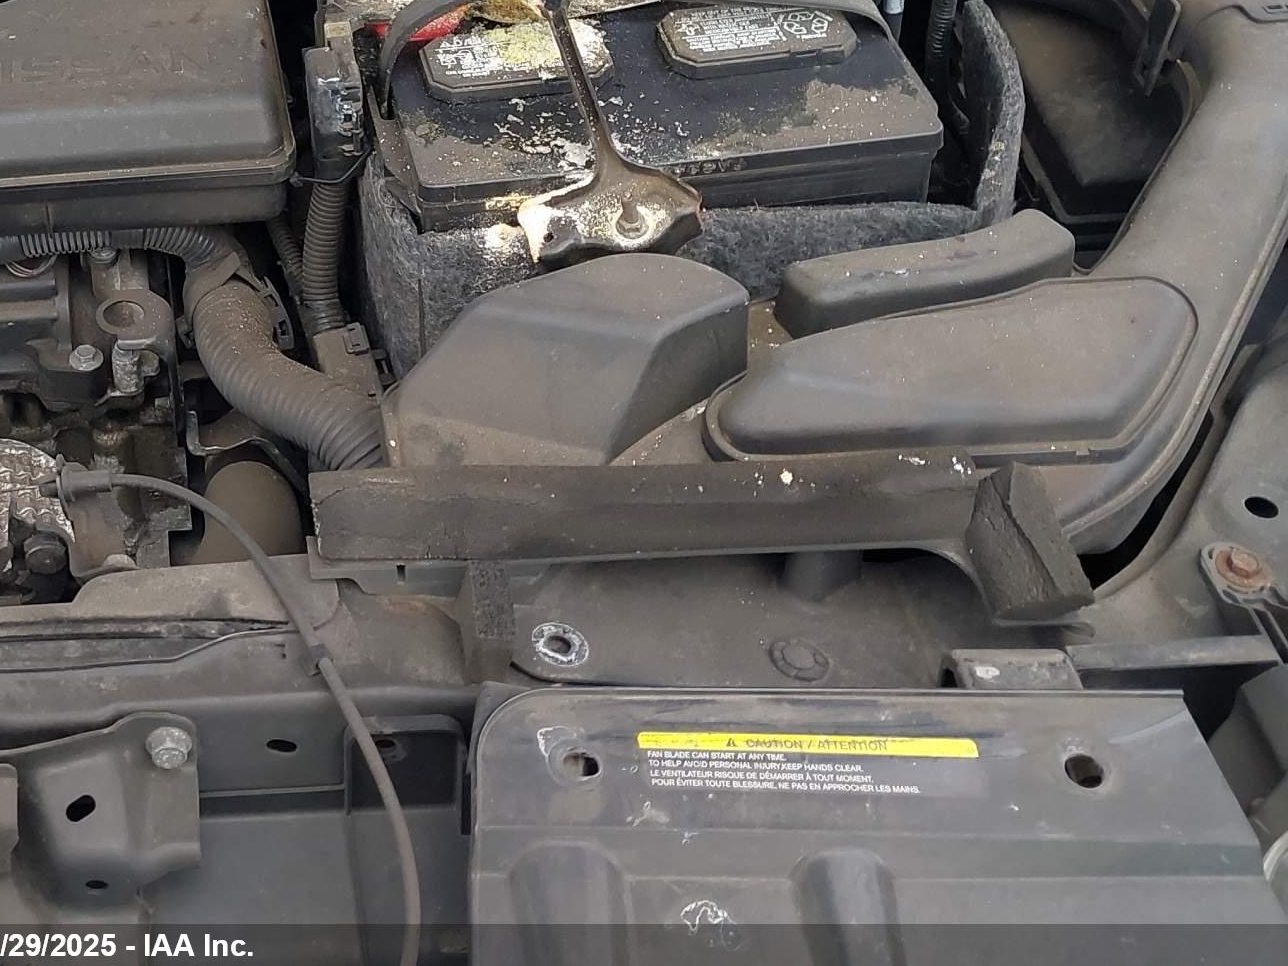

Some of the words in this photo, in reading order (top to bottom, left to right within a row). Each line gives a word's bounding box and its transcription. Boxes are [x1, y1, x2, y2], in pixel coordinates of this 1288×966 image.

[746, 738, 803, 748] CAUTION
[818, 738, 889, 751] ATTENTION
[711, 752, 734, 760] START
[737, 752, 746, 760] AT
[748, 752, 764, 760] ANY
[662, 760, 682, 768] HELP
[684, 760, 708, 768] AVOID
[709, 761, 752, 769] PERSONAL
[804, 764, 834, 772] HANDS
[661, 770, 713, 778] VENTILATEUR
[714, 771, 745, 779] RISQUE
[746, 772, 758, 780] DE
[759, 770, 804, 780] DÉMARRER
[806, 771, 812, 780] À
[813, 774, 834, 782] TOUT
[652, 778, 675, 786] POUR
[676, 776, 703, 787] ÉVITER
[705, 780, 730, 788] TOUTE
[779, 782, 789, 790] NE
[792, 782, 808, 790] PAS
[822, 783, 874, 792] APPROCHER
[875, 784, 891, 792] LES
